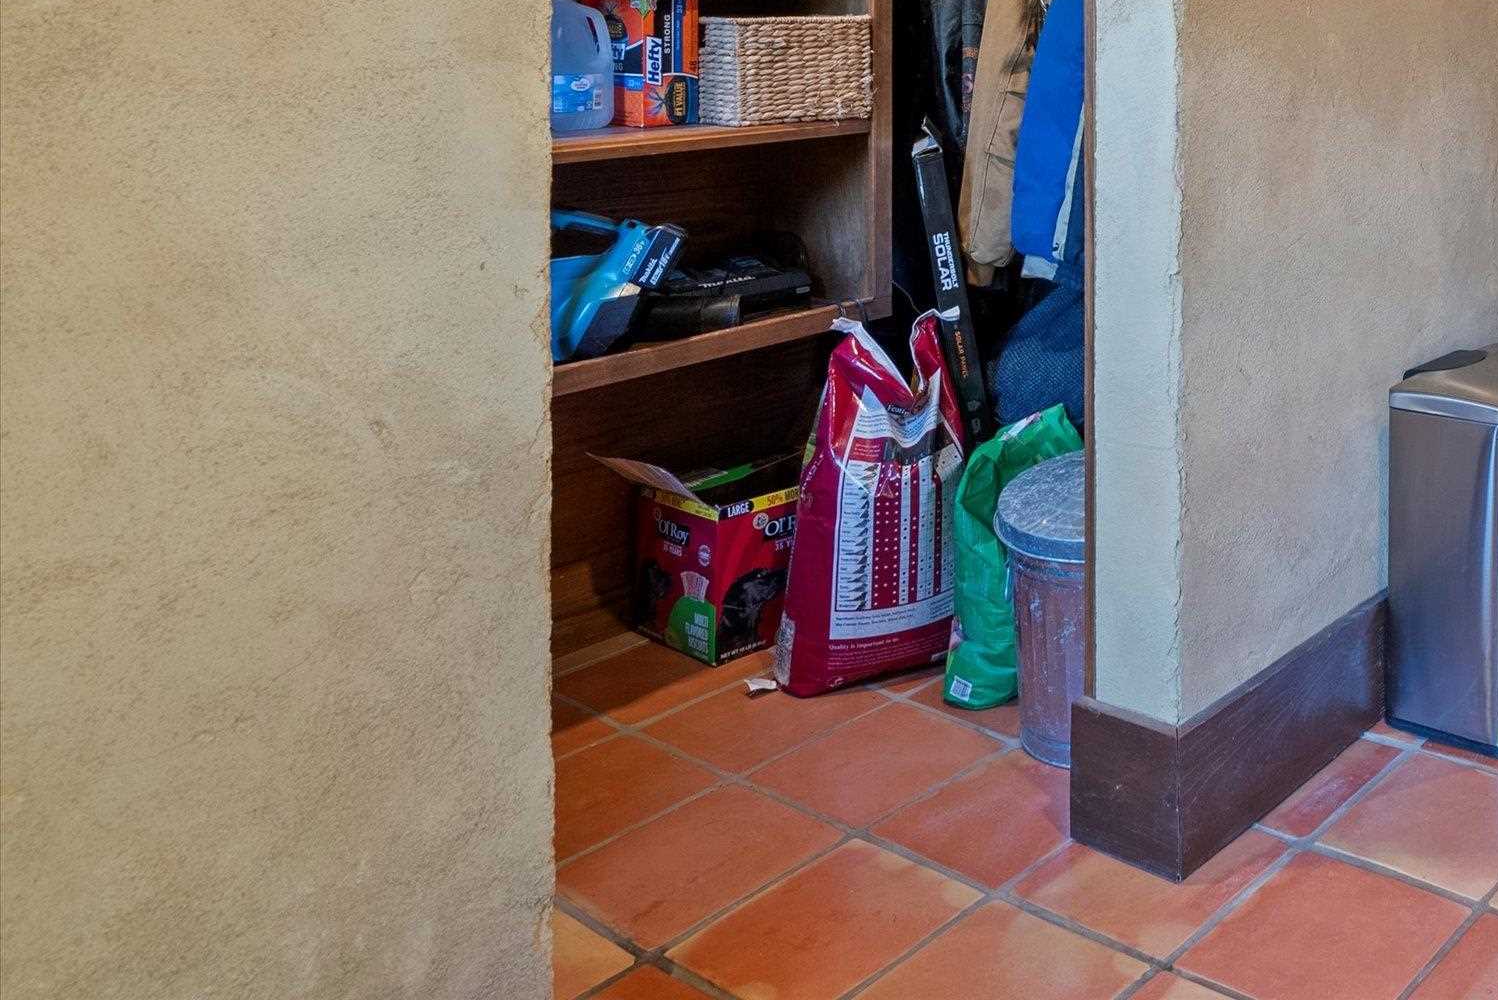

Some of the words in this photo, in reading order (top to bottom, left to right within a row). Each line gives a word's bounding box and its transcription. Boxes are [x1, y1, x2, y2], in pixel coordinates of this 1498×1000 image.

[647, 38, 661, 83] Hefty
[933, 233, 952, 291] SOLAR
[943, 231, 959, 288] THUNDERBOLT
[728, 502, 750, 518] LARGE
